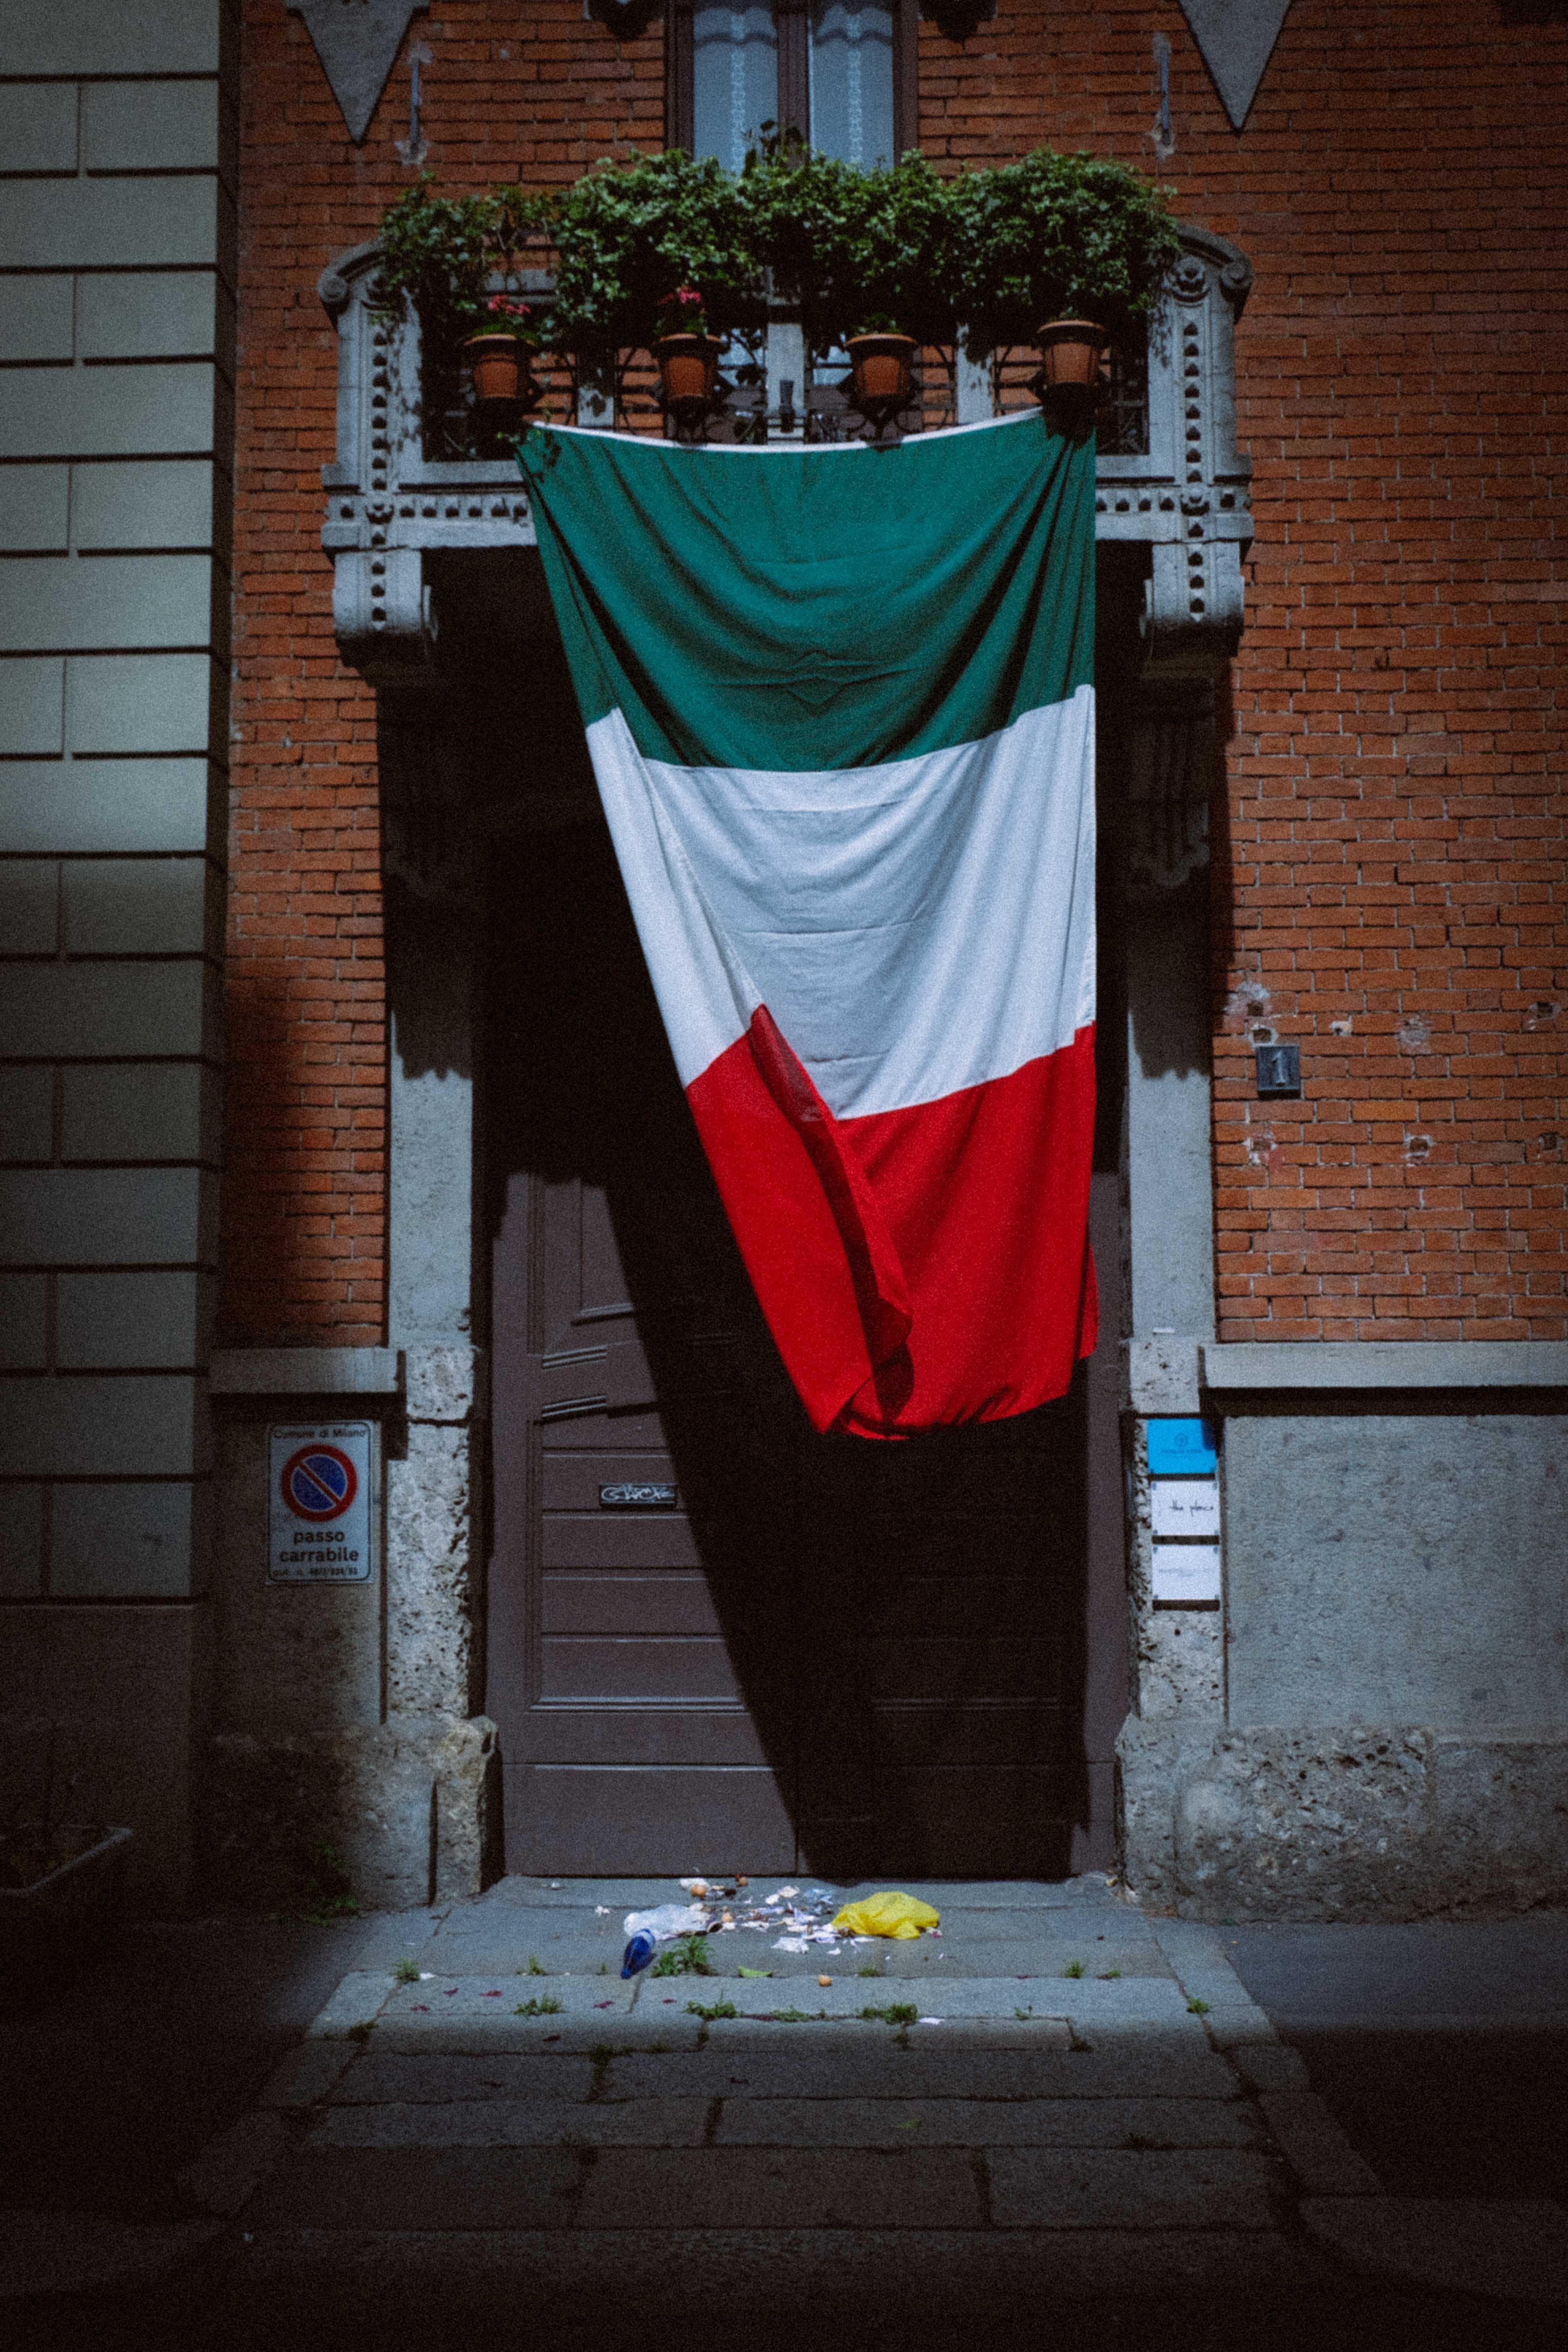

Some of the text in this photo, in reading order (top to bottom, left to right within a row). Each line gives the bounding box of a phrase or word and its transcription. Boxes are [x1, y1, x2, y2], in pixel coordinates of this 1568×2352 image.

[1272, 1049, 1287, 1084] 1
[294, 1531, 345, 1544] passo
[279, 1547, 359, 1562] carrabile
